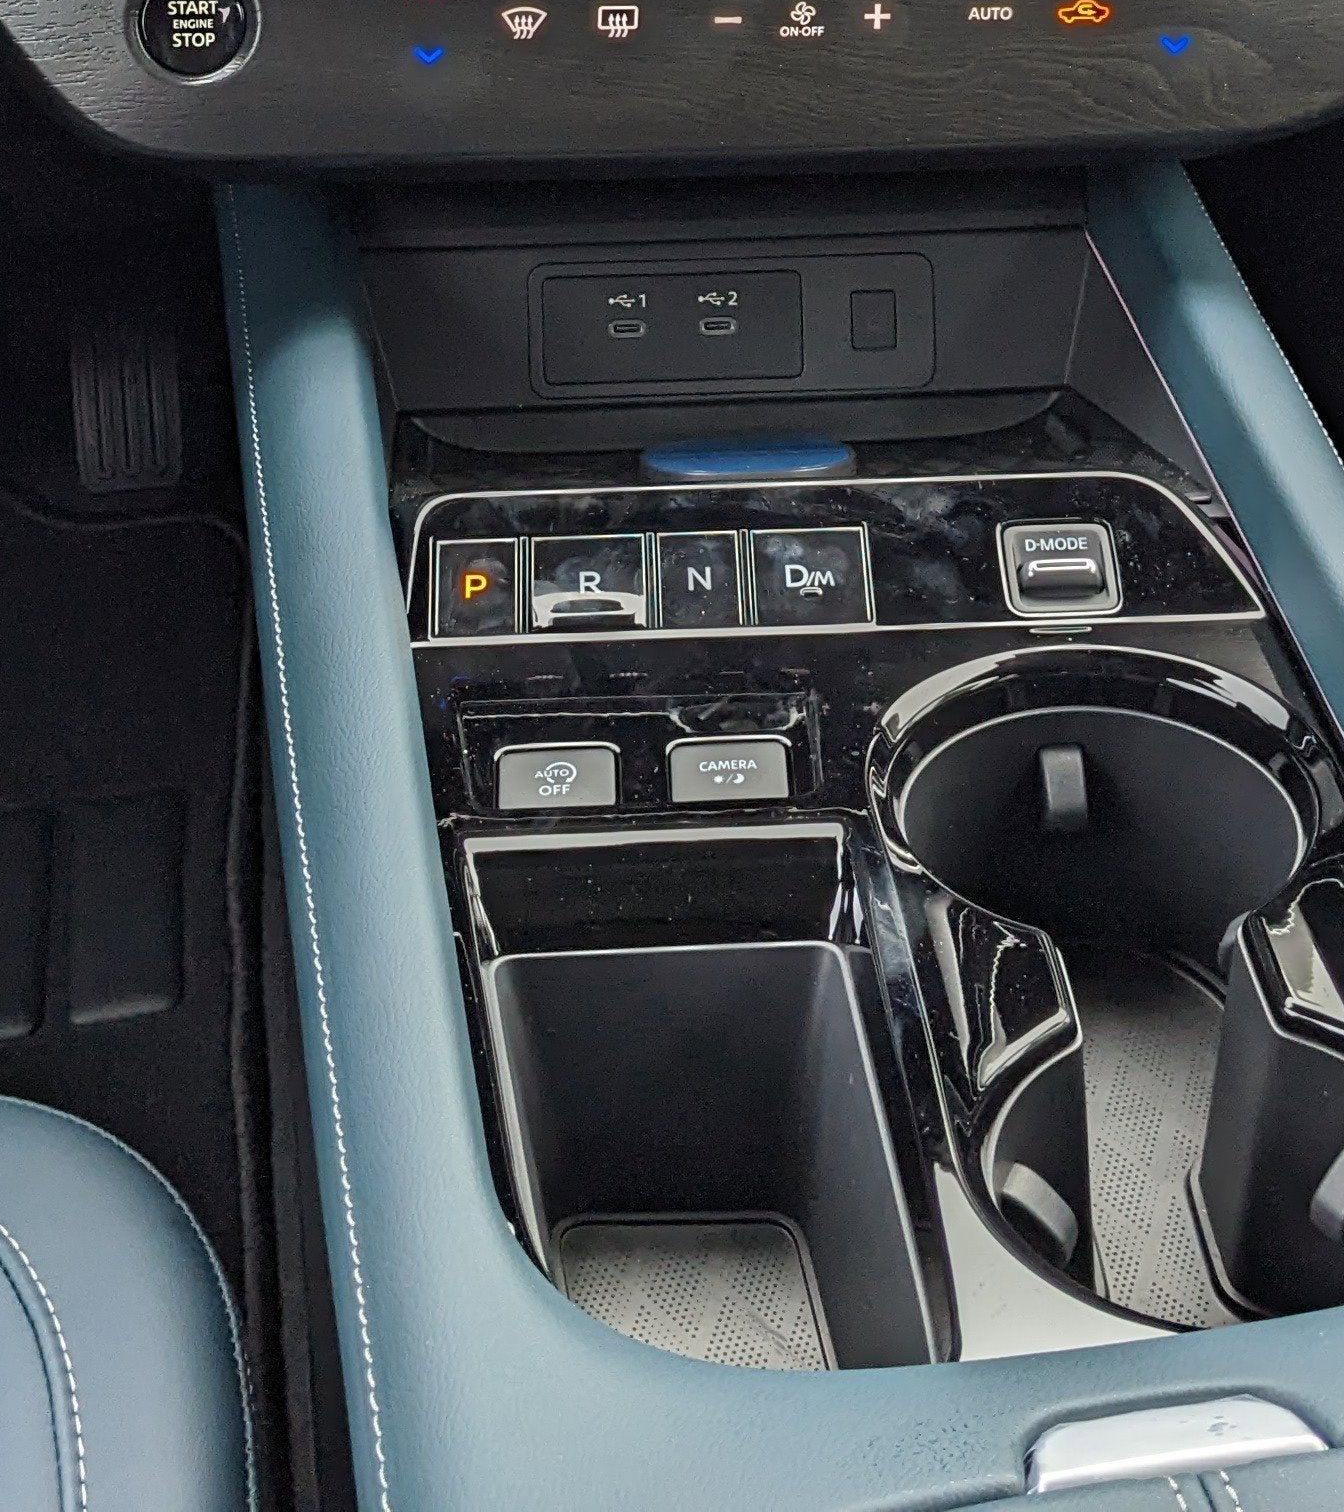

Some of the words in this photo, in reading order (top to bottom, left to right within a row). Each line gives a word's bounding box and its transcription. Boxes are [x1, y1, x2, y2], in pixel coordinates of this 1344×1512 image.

[167, 0, 219, 17] START
[968, 6, 1013, 22] AUTO
[172, 19, 214, 29] ENGINE
[172, 32, 216, 48] STOP
[464, 574, 488, 599] P
[578, 571, 601, 594] R
[687, 566, 713, 591] N
[534, 768, 570, 779] AUTO
[699, 759, 758, 772] CAMERA
[538, 784, 571, 796] OFF
